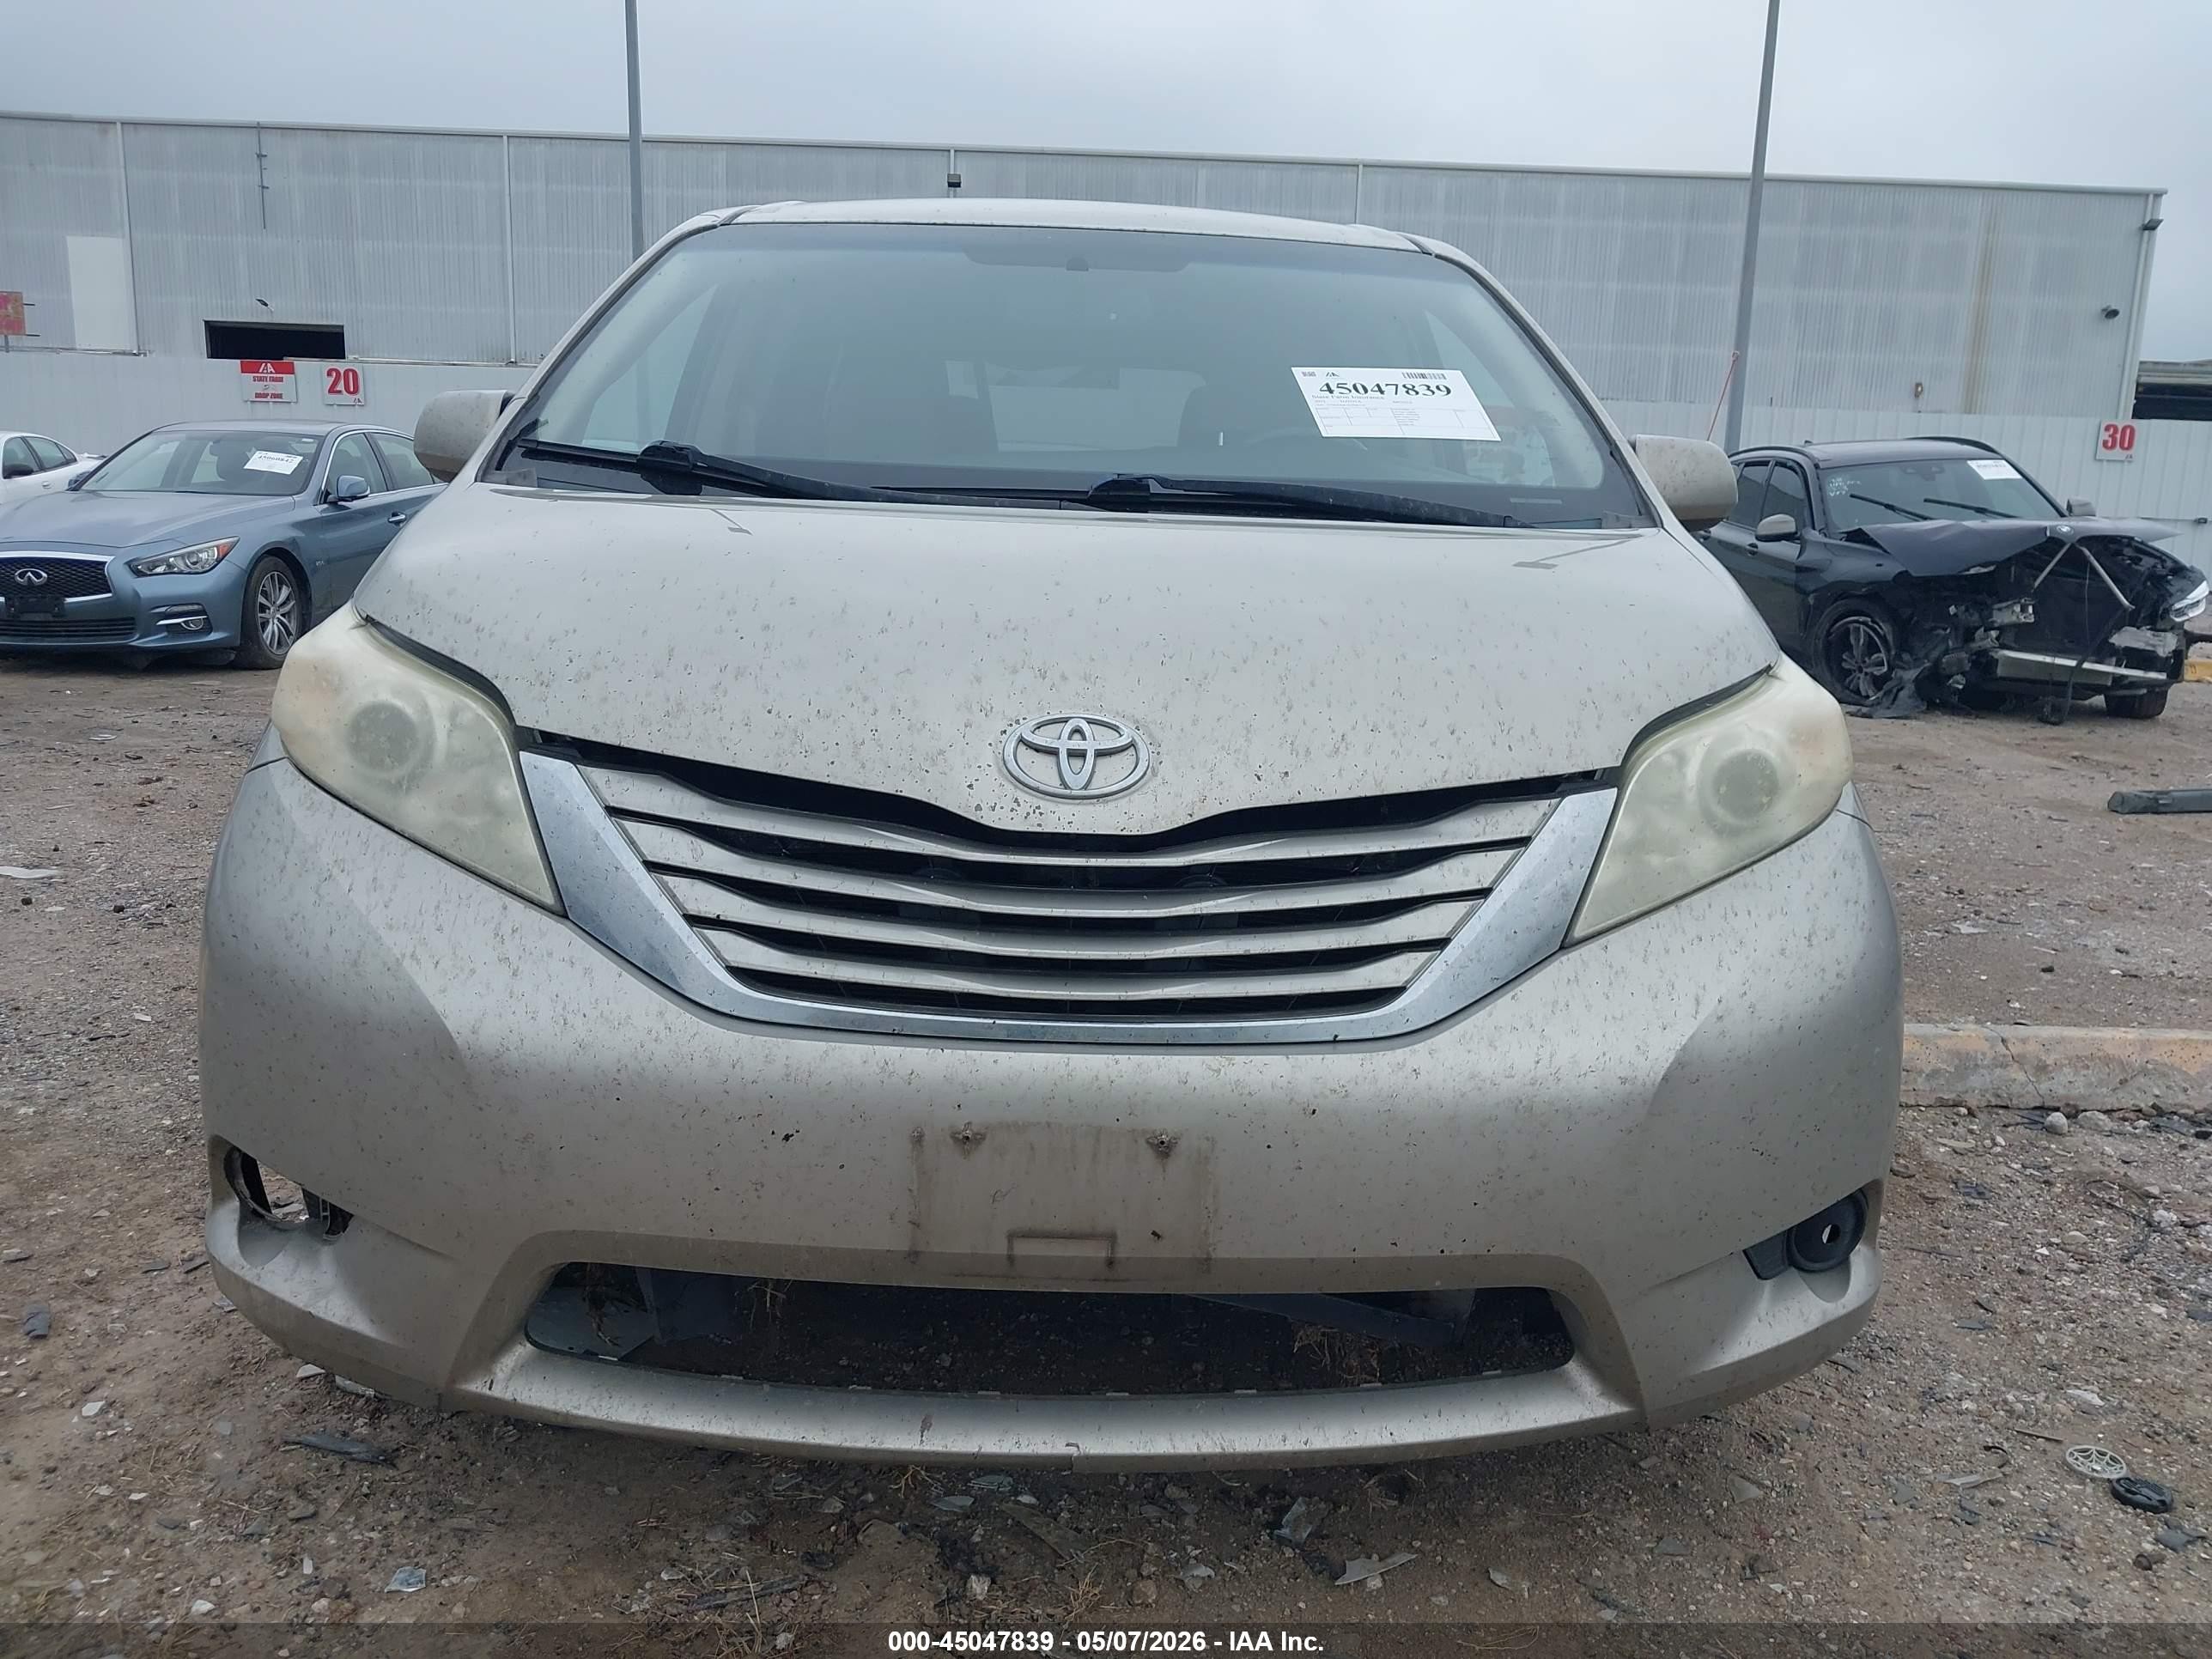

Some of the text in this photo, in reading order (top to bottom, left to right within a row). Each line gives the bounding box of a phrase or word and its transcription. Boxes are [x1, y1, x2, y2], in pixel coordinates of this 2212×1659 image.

[326, 368, 359, 396] 20
[1319, 382, 1452, 397] 45047839
[2102, 423, 2136, 451] 30
